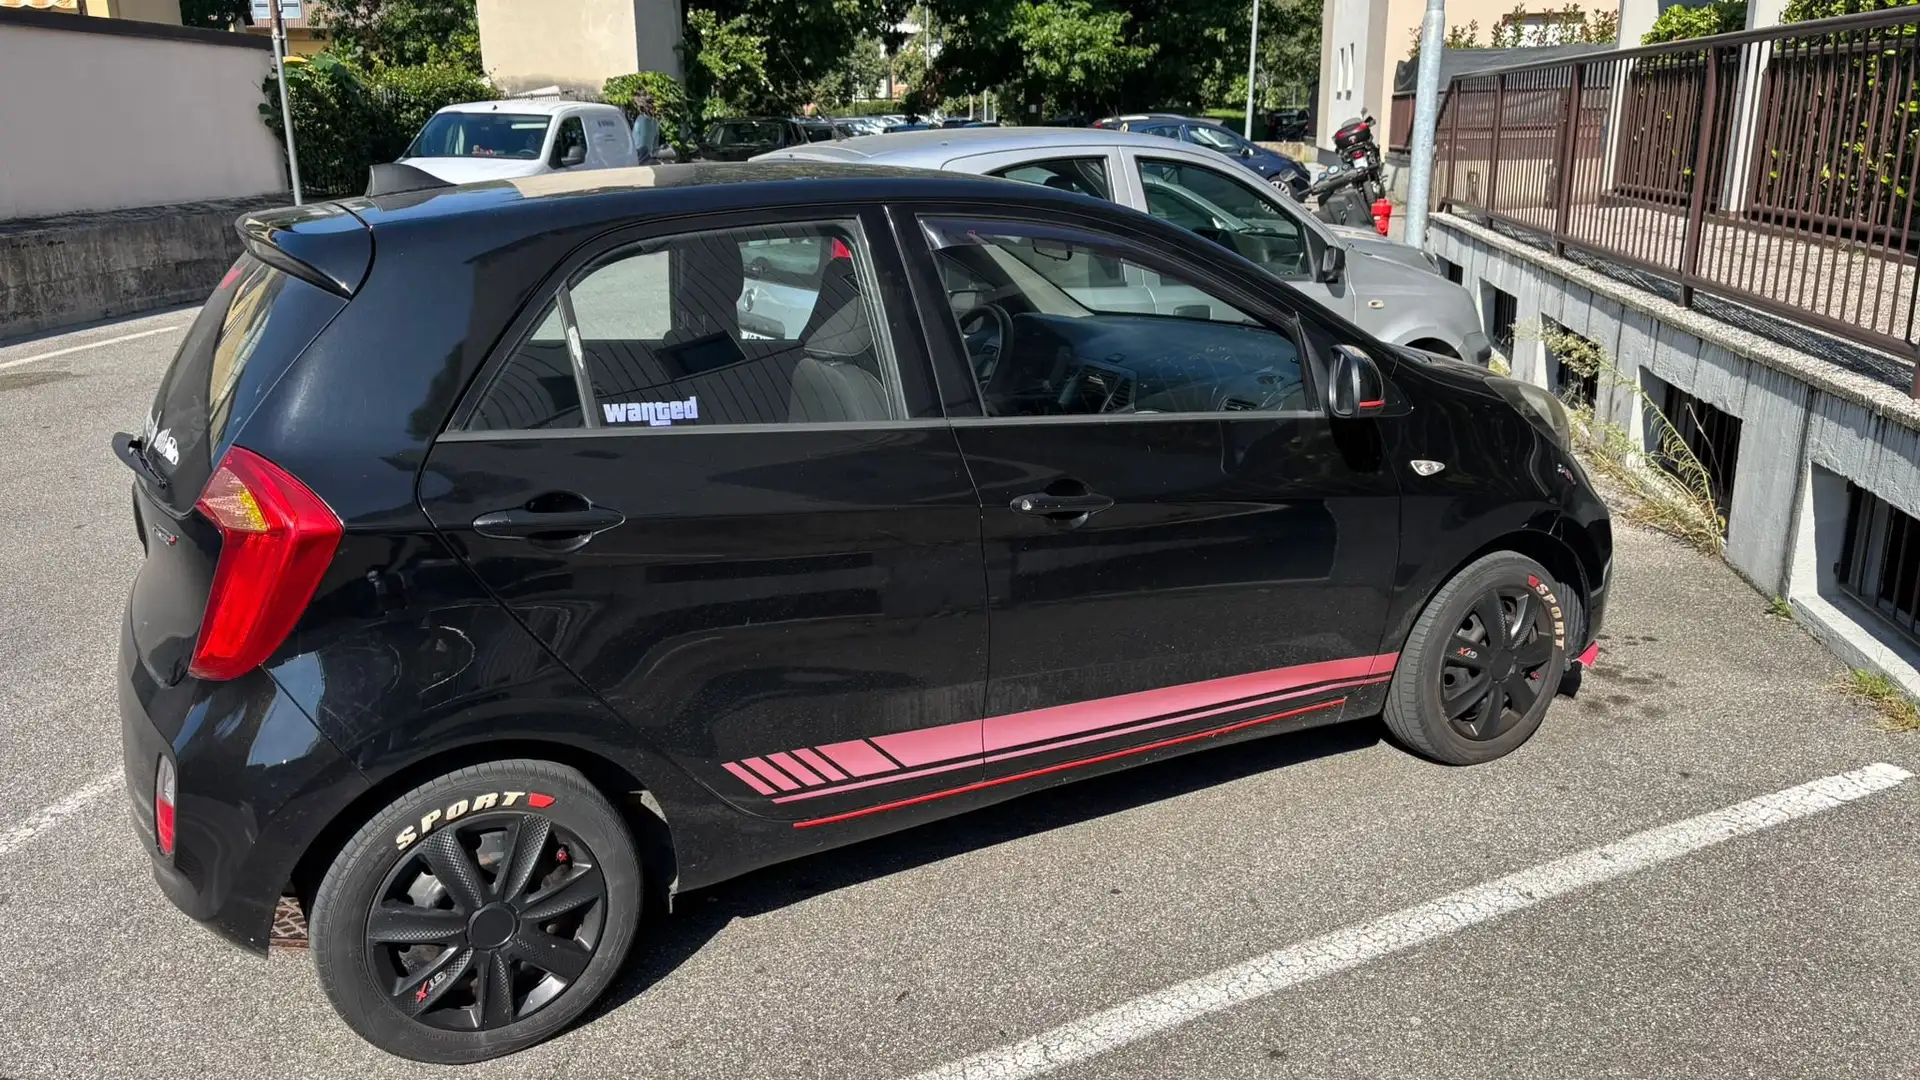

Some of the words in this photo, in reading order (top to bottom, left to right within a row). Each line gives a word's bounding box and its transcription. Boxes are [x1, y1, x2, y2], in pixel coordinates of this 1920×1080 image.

[603, 396, 698, 426] wanted
[1536, 583, 1565, 651] SPORT
[395, 791, 526, 851] SPORT
